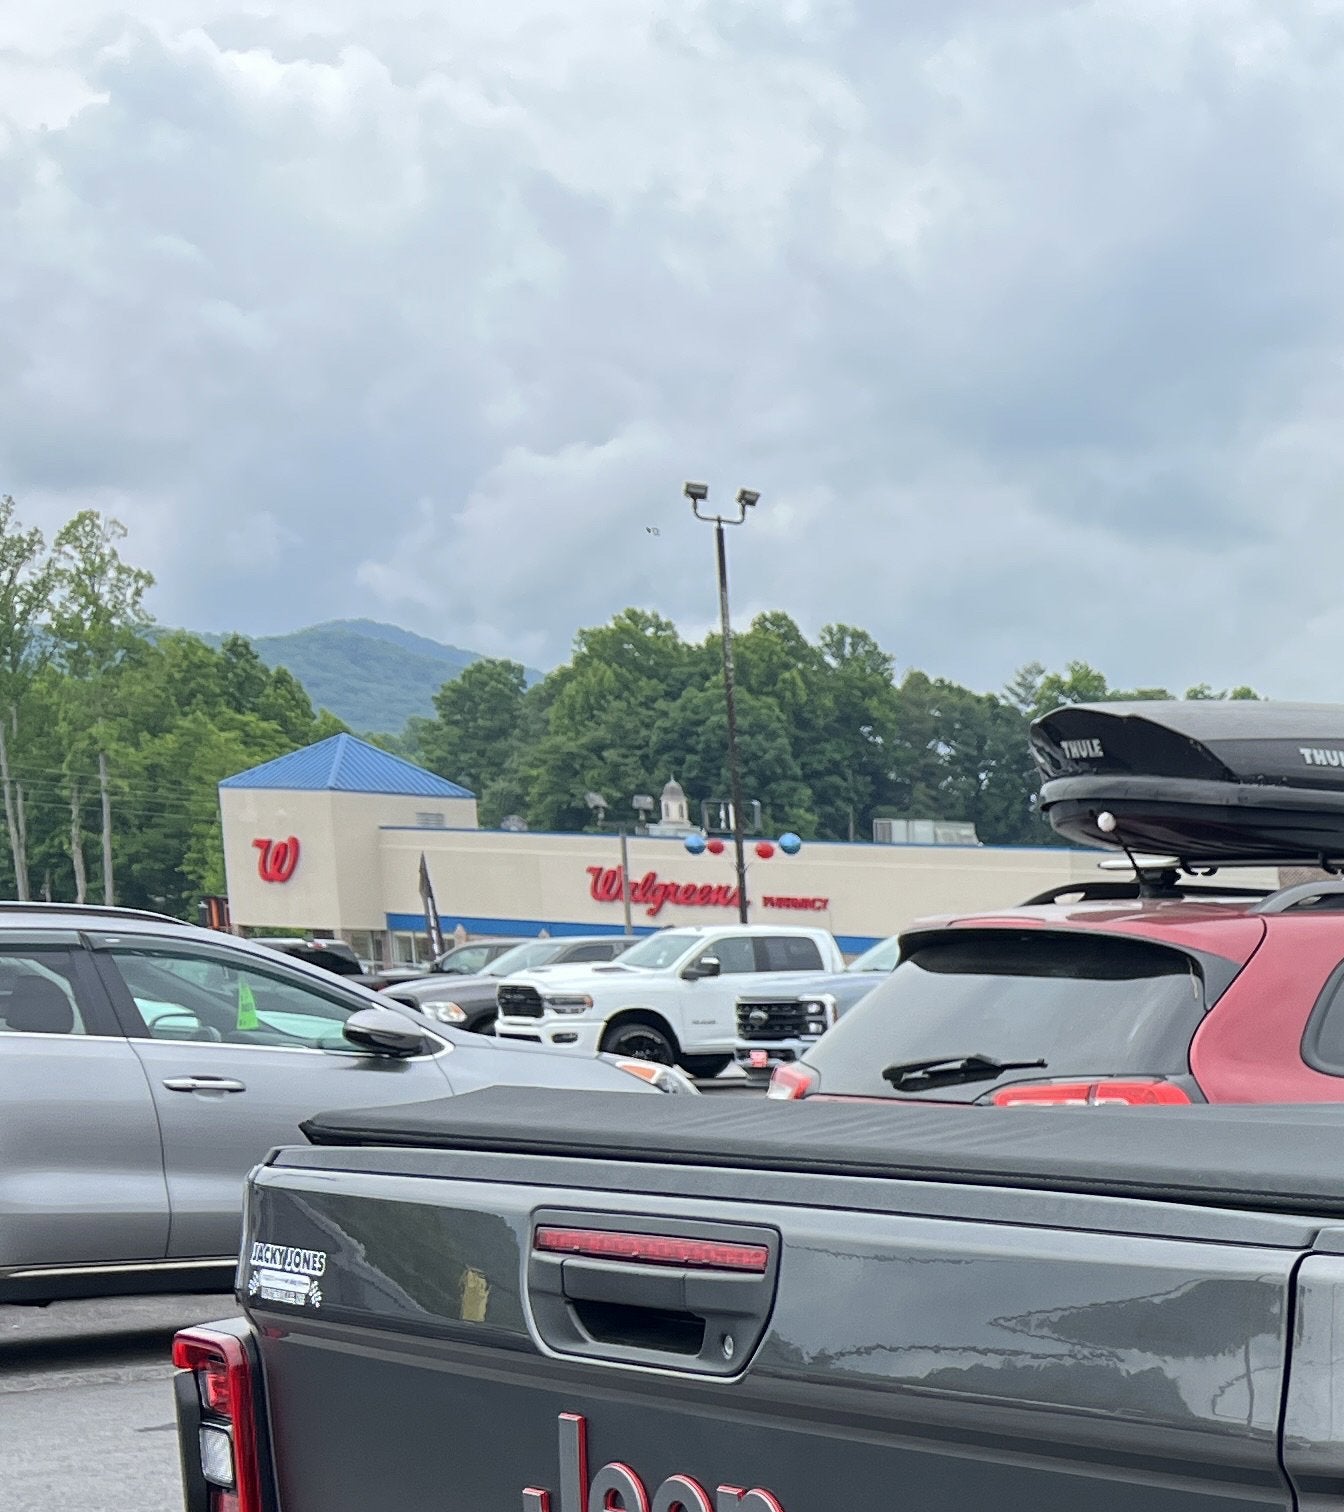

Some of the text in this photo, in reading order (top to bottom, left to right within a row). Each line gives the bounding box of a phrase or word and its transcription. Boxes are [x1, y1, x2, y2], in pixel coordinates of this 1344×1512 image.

[1060, 739, 1104, 759] THULE
[251, 835, 300, 883] W
[251, 1242, 326, 1273] JACKY JONES
